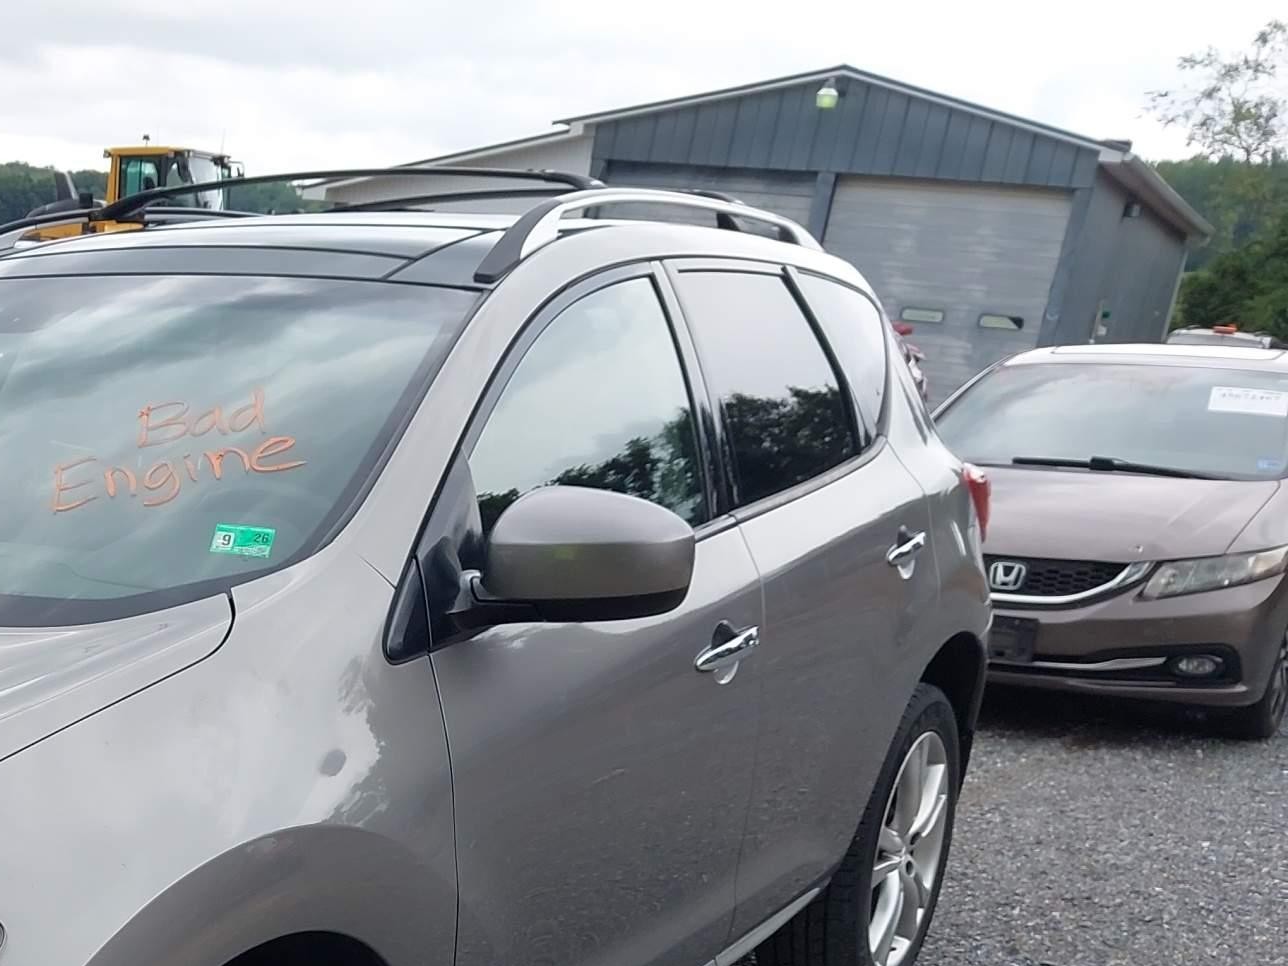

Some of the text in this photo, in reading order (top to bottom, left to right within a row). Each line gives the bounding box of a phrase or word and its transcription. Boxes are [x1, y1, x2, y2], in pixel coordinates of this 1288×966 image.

[137, 387, 266, 448] Bad
[52, 435, 308, 514] Engine
[222, 533, 232, 546] 9
[253, 532, 270, 545] 26
